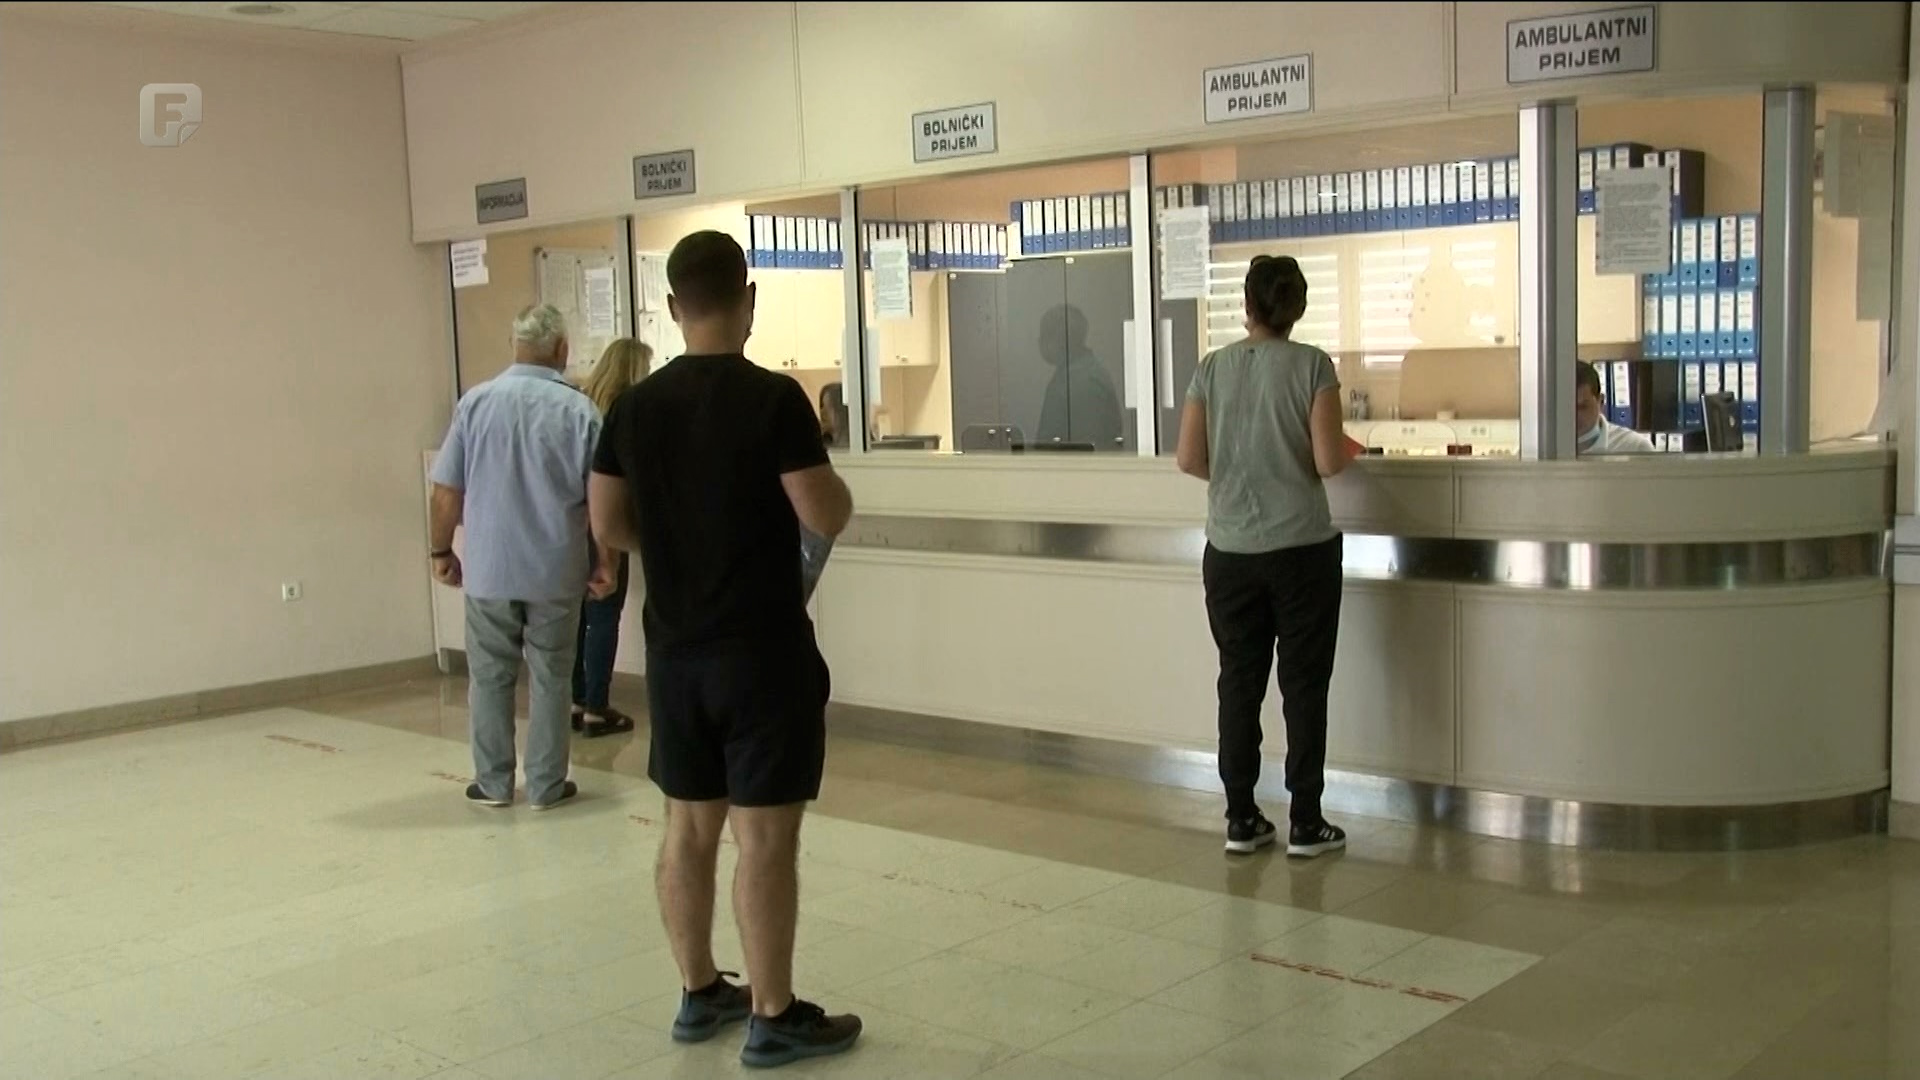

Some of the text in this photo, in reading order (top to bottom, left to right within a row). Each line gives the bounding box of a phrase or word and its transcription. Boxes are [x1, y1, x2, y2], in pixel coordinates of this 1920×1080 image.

[1515, 16, 1647, 49] AMBULANTNI
[1539, 47, 1620, 71] PRIJEM
[1210, 64, 1305, 93] AMBULANTNI
[1228, 91, 1287, 113] PRIJEM
[923, 114, 984, 137] BOLNIČKI
[931, 135, 977, 153] PRIJEM
[641, 158, 687, 178] BOLNIČKI
[647, 177, 682, 192] PRIJEM
